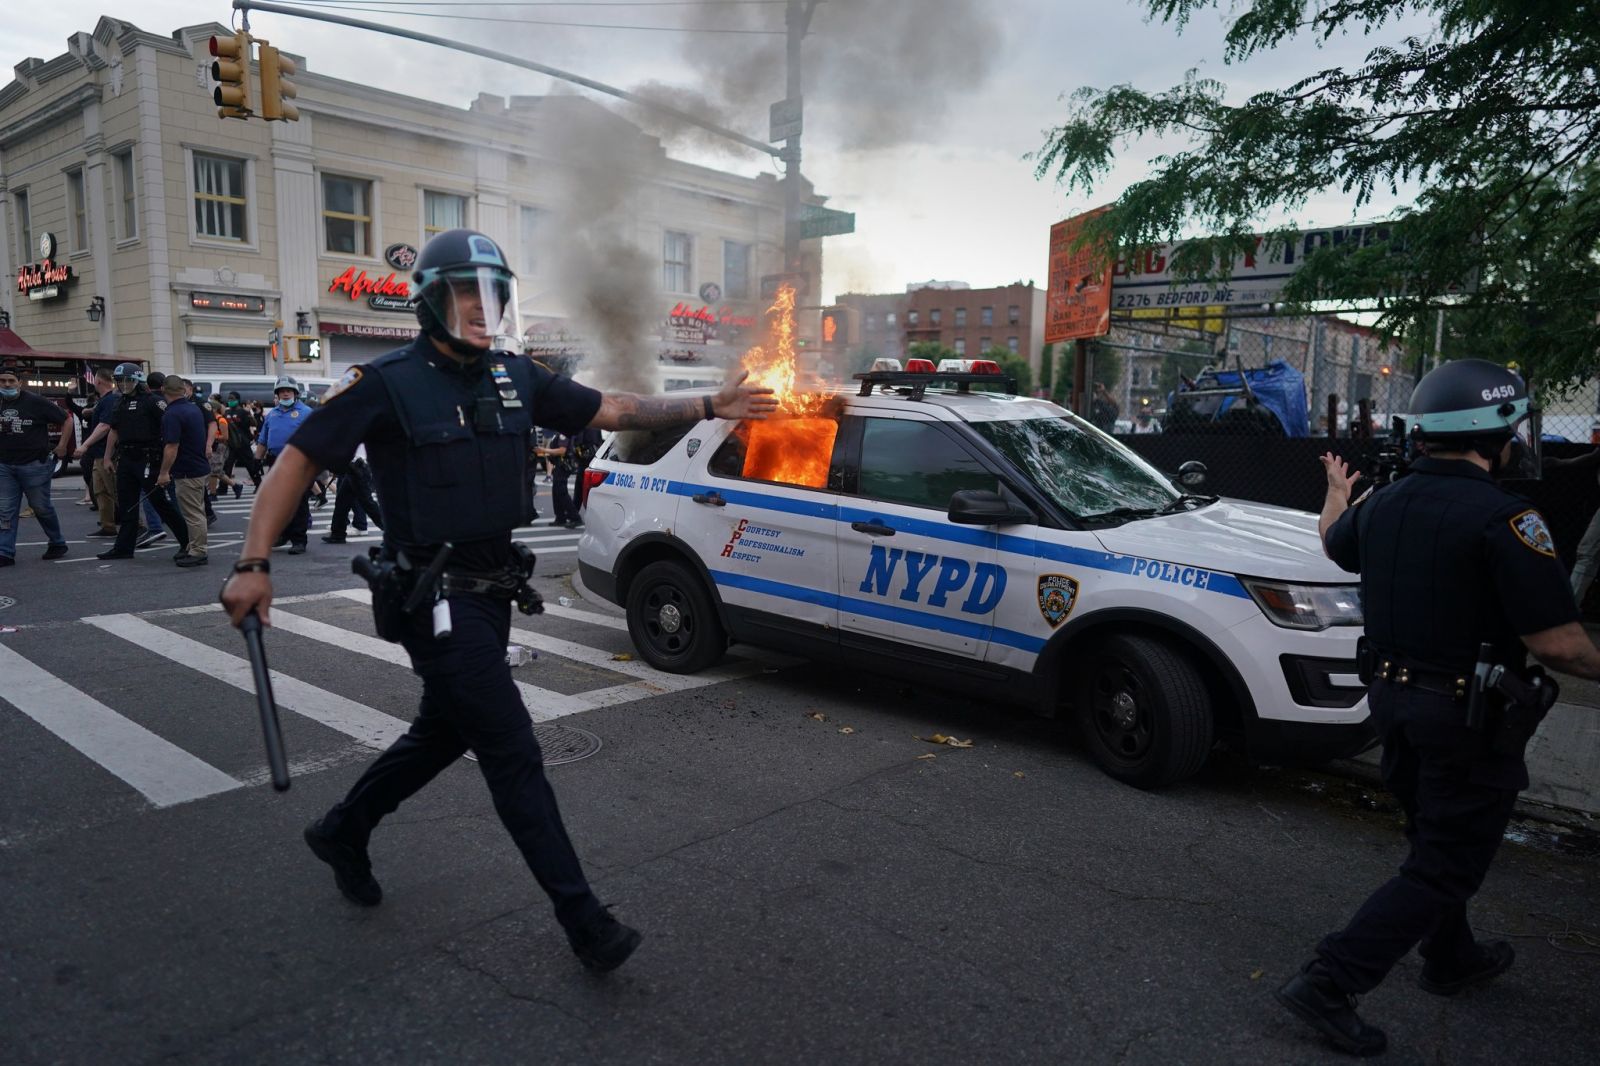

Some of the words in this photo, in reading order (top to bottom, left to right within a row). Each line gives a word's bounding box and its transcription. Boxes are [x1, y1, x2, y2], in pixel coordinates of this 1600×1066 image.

[328, 266, 409, 300] Afrika
[1117, 294, 1151, 308] 2276
[1157, 290, 1209, 306] BEDFORD
[1481, 384, 1516, 401] 6450
[616, 473, 634, 489] 3602
[639, 476, 650, 490] 70
[651, 477, 667, 492] PCT
[738, 518, 781, 538] COURTESY
[720, 544, 762, 563] RESPECT
[729, 531, 805, 557] PROFESSIONALISM
[859, 544, 1008, 615] NYPD
[1048, 576, 1071, 586] POLICE
[1132, 558, 1208, 590] POLICE
